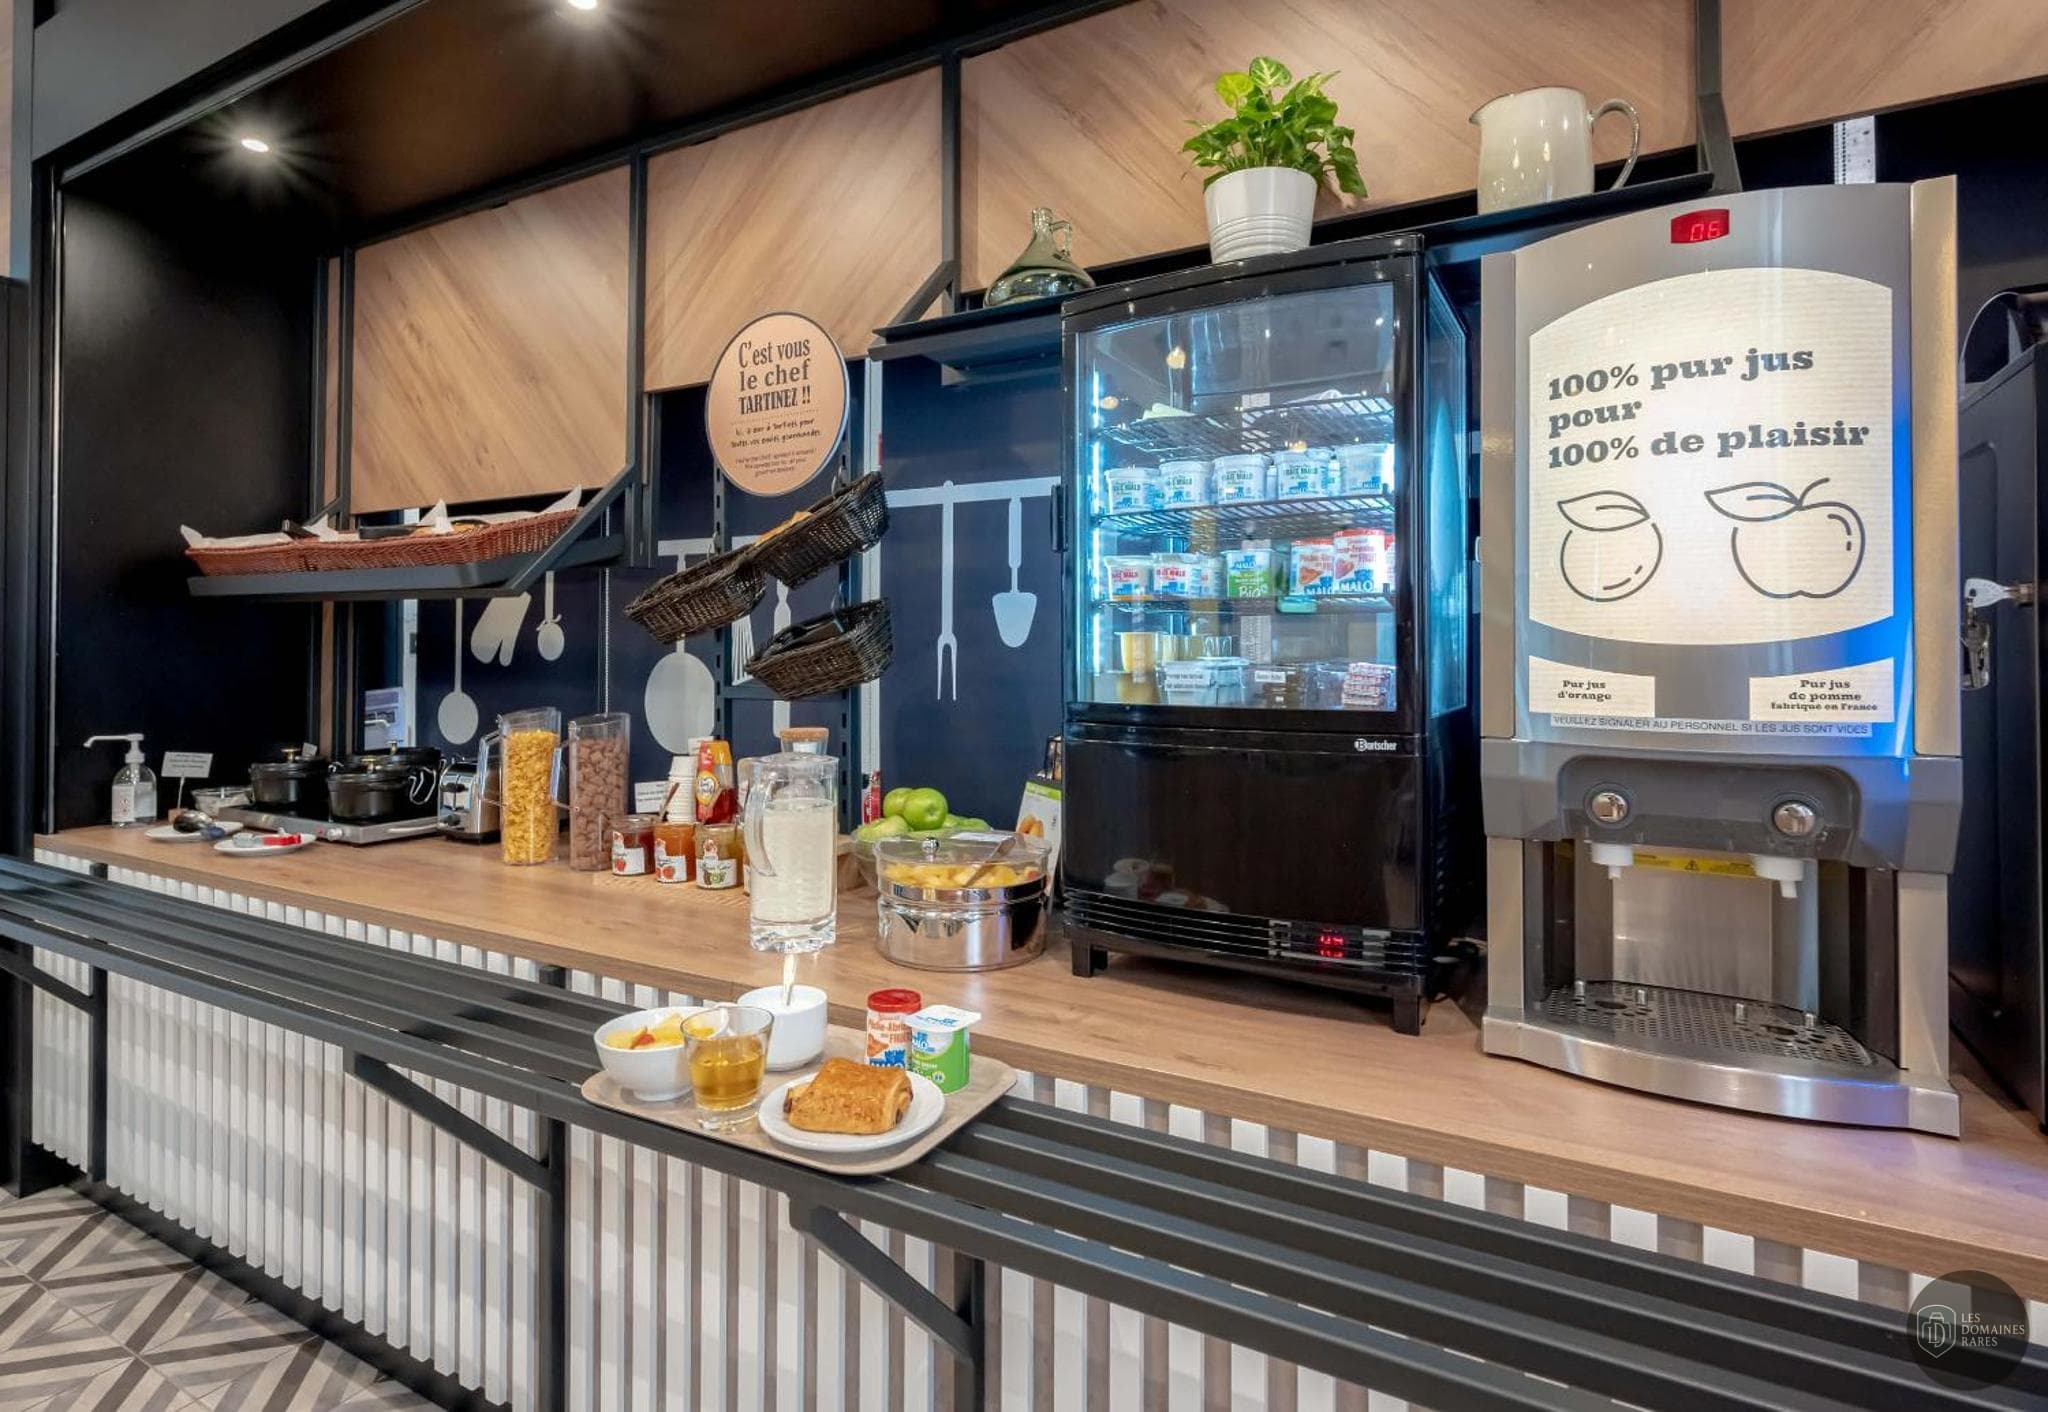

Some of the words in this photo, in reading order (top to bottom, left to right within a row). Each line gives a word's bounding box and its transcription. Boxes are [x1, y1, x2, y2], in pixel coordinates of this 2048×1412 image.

[1690, 221, 1720, 241] 06
[738, 341, 774, 368] C'est
[777, 338, 811, 360] vous
[739, 371, 758, 392] le
[764, 358, 812, 387] chef
[1548, 363, 1640, 401] 100%
[1650, 356, 1734, 391] pur
[1740, 348, 1814, 381] jus
[738, 386, 798, 415] TARTINEZ
[1548, 400, 1643, 439] pour
[1548, 435, 1640, 469] 100%
[1651, 431, 1705, 456] de
[1717, 420, 1870, 458] plaisir
[1562, 679, 1585, 689] Pur
[1586, 679, 1606, 690] jus
[1800, 679, 1827, 689] Pur
[1828, 679, 1850, 690] jus
[1557, 691, 1612, 702] d'orange
[1788, 691, 1806, 701] de
[1809, 692, 1862, 703] pomme
[1840, 703, 1878, 711] France
[1552, 716, 1597, 726] VEUILLEZ
[1599, 717, 1650, 728] SIGNALER
[1653, 720, 1669, 729] AU
[1670, 720, 1740, 731] PERSONNEL
[1741, 723, 1752, 732] SI
[1755, 723, 1777, 733] LES
[1779, 724, 1801, 733] JUS
[1803, 724, 1833, 734] SONT
[1836, 725, 1868, 734] VIDES
[1353, 738, 1398, 752] Bartscher
